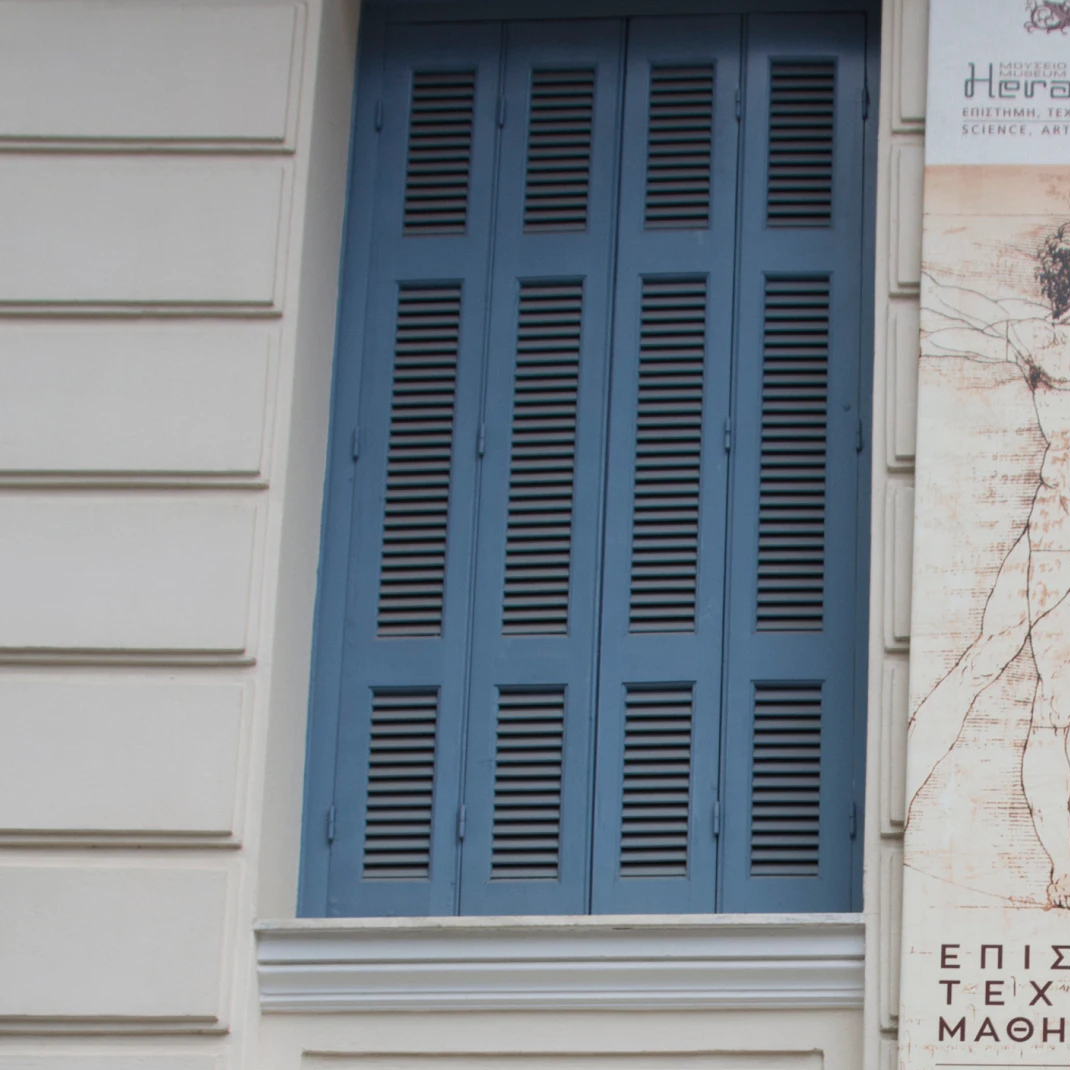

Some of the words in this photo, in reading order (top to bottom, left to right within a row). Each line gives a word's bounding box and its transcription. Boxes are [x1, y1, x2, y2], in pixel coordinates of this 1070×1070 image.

[999, 61, 1067, 70] ΜΟΥΣΕΙΟ
[999, 69, 1067, 78] MUSEUM
[961, 107, 1041, 119] ΕΠΙΣΤΗΜΗ,
[961, 123, 1034, 136] SCIENCE,
[1041, 124, 1070, 135] ART
